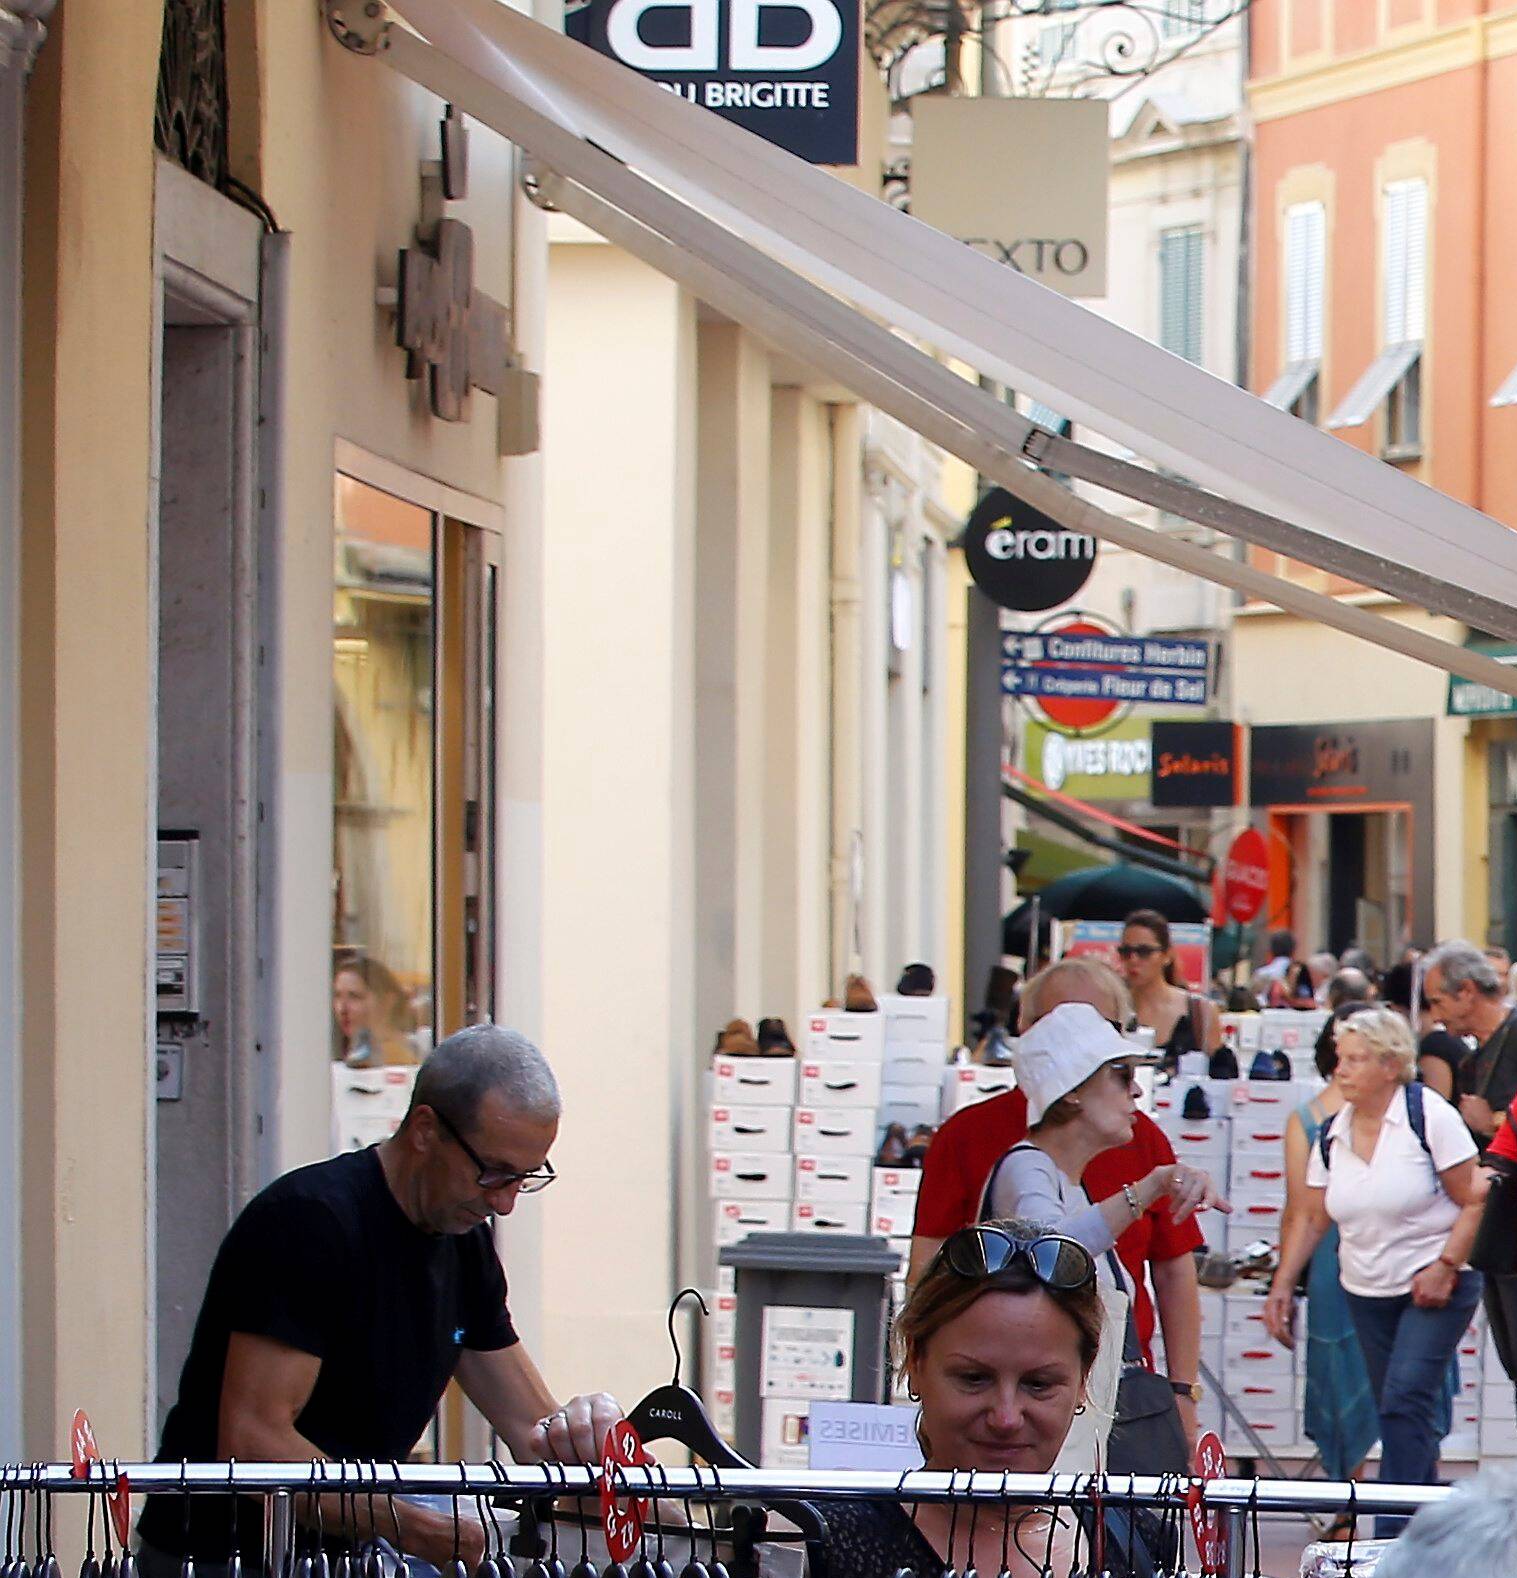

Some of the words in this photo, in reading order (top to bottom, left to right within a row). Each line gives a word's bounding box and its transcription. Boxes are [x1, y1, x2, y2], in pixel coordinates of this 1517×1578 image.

[704, 82, 830, 109] BRIGITTE
[985, 516, 1095, 560] éram
[1148, 677, 1173, 700] de
[1109, 738, 1152, 776] ROC
[649, 1408, 682, 1420] CAROLL
